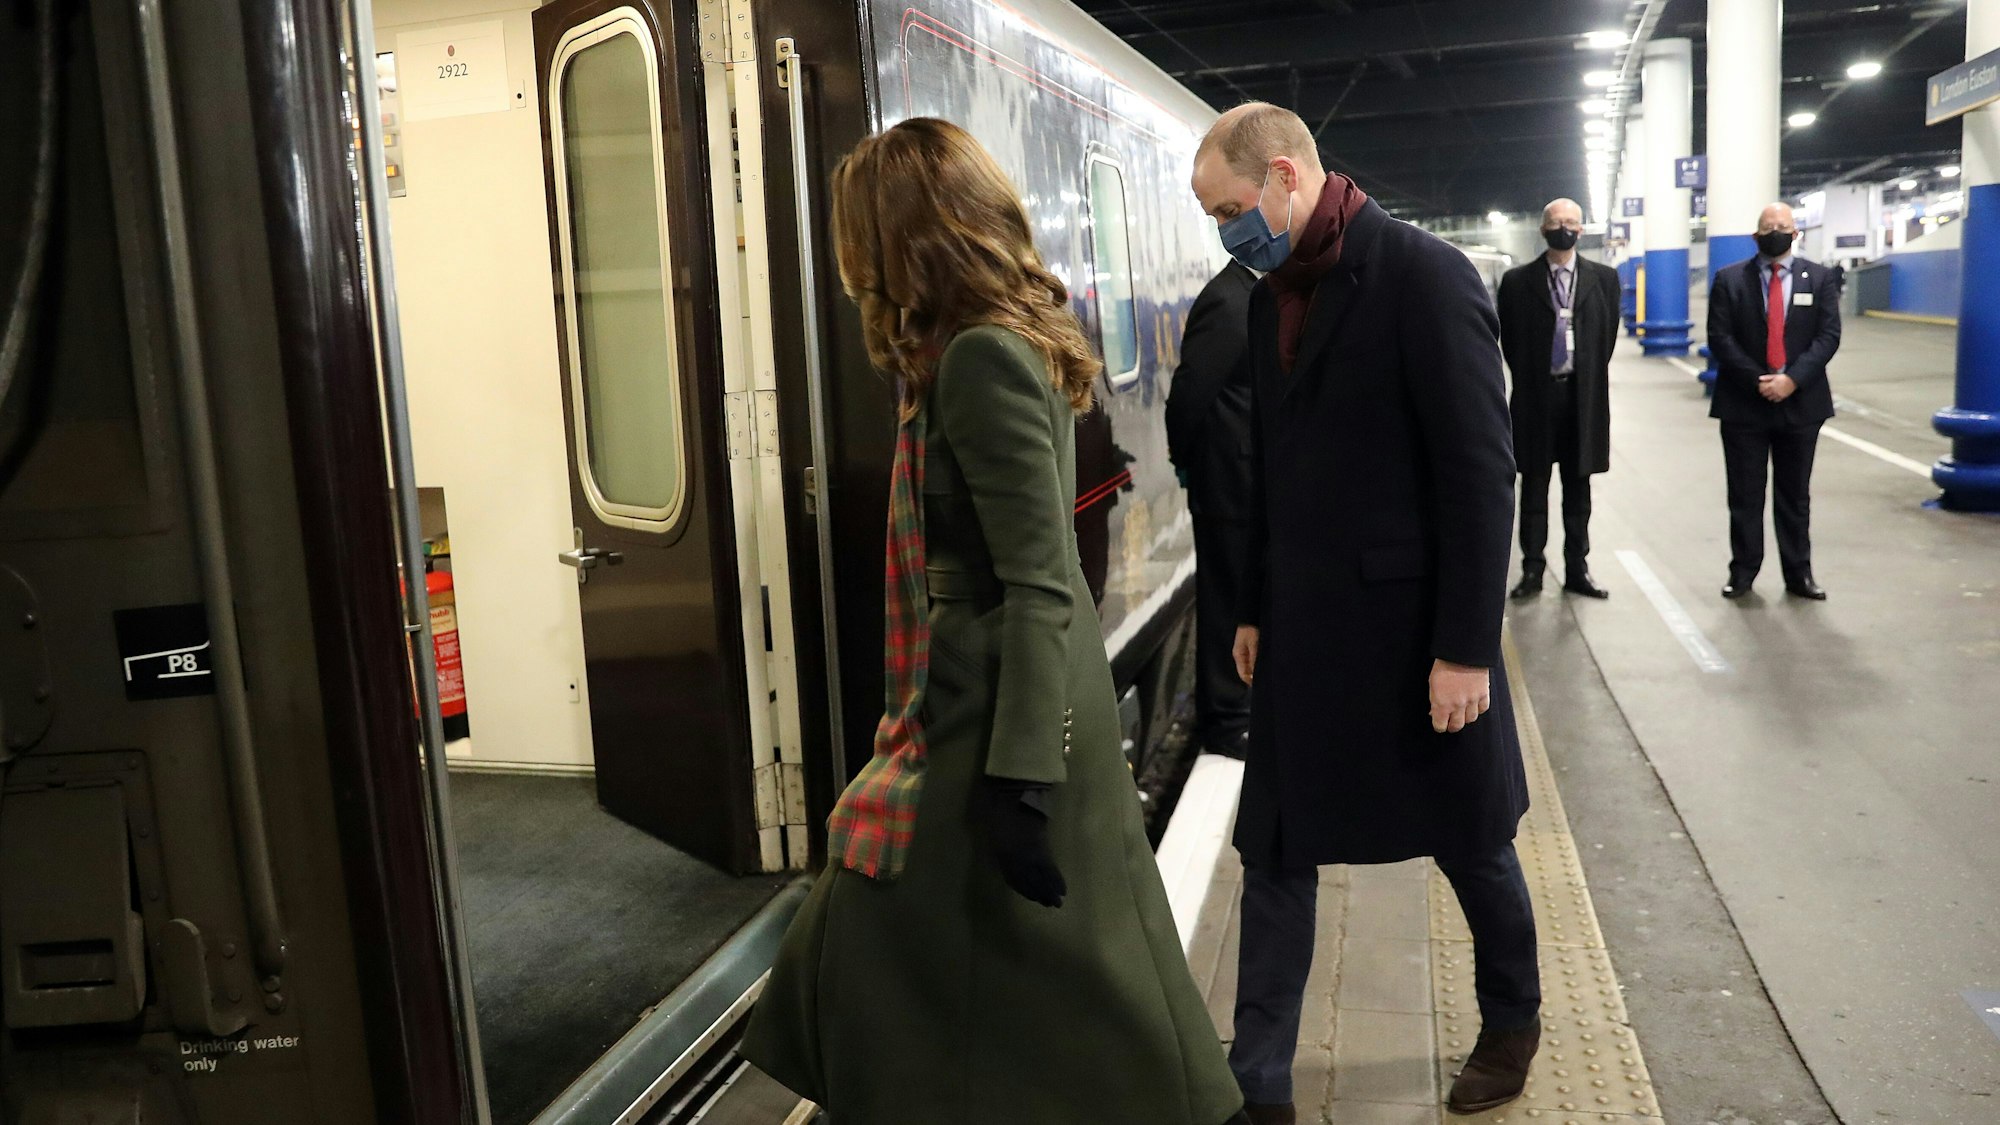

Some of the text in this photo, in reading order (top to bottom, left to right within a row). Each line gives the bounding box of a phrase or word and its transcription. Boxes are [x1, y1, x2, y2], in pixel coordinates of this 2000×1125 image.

[437, 63, 469, 79] 2922
[1941, 65, 1997, 103] London Euston
[168, 653, 198, 673] P8
[181, 1035, 299, 1054] Drinking water
[184, 1057, 217, 1072] only
